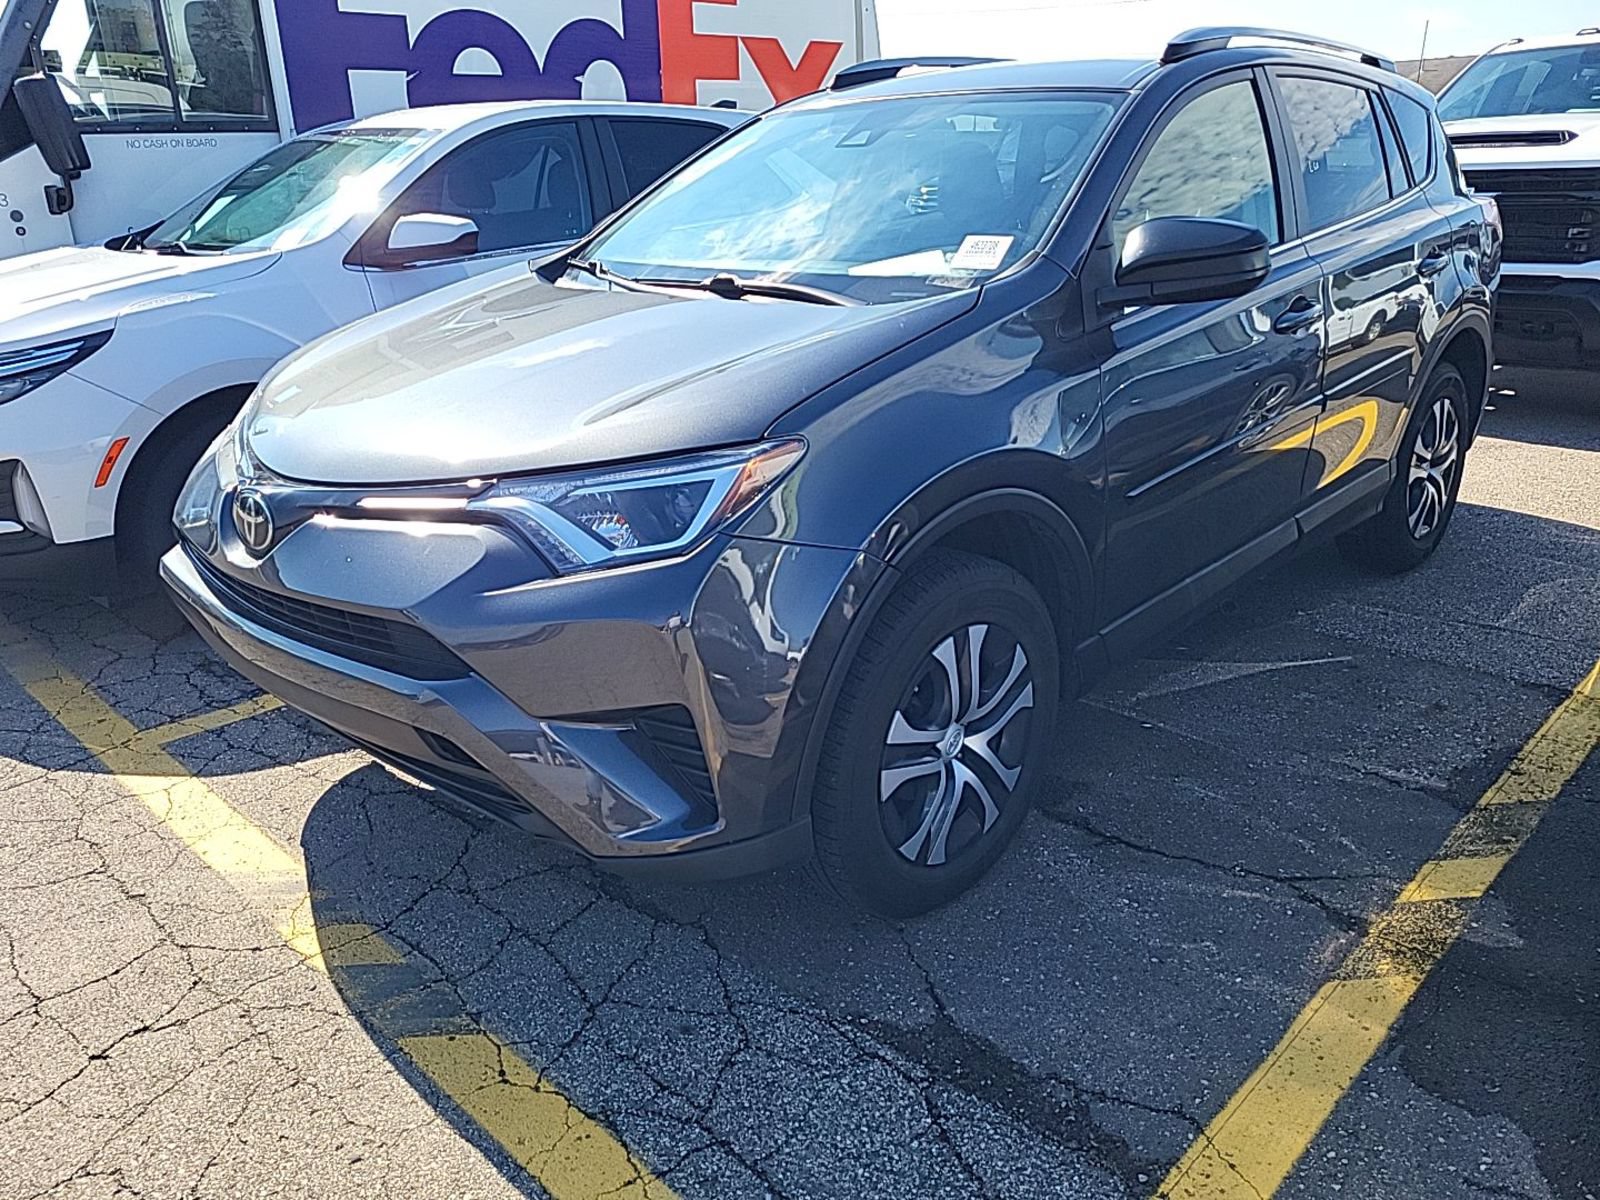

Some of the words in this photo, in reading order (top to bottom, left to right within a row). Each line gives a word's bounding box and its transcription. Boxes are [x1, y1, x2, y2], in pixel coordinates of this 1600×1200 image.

[274, 0, 843, 136] FedEx
[126, 139, 141, 149] NO
[143, 139, 168, 149] CASH
[170, 138, 184, 148] ON
[187, 138, 218, 148] BOARD
